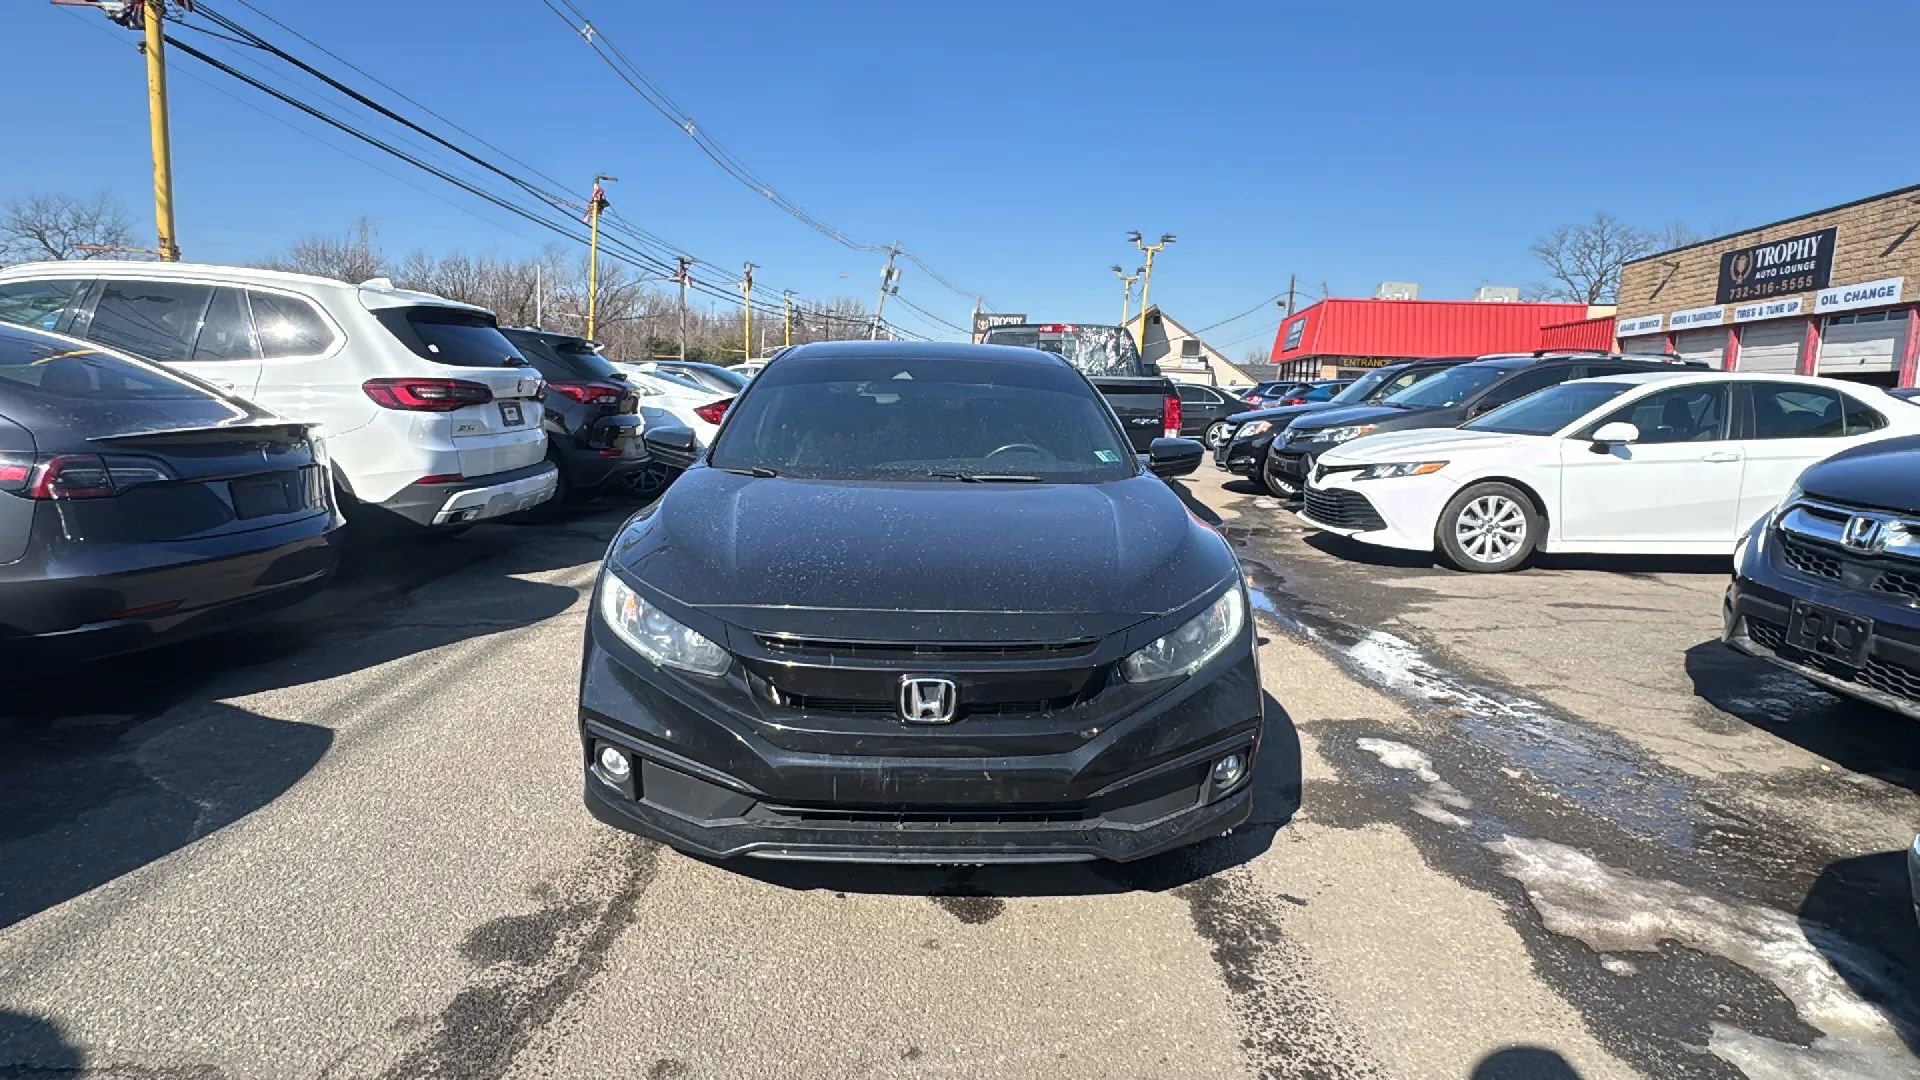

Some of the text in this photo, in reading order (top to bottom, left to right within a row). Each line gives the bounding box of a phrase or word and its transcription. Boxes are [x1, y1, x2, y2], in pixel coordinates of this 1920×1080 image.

[1755, 234, 1823, 268] TROPHY
[1755, 260, 1817, 280] AUTO LOUNGE
[1729, 275, 1813, 300] 732-316-5555
[1821, 285, 1896, 306] OIL CHANGE
[1737, 307, 1756, 319] TIRES
[1765, 304, 1785, 316] TUNE
[1787, 301, 1799, 312] UP
[1343, 358, 1392, 367] ENTRANCE
